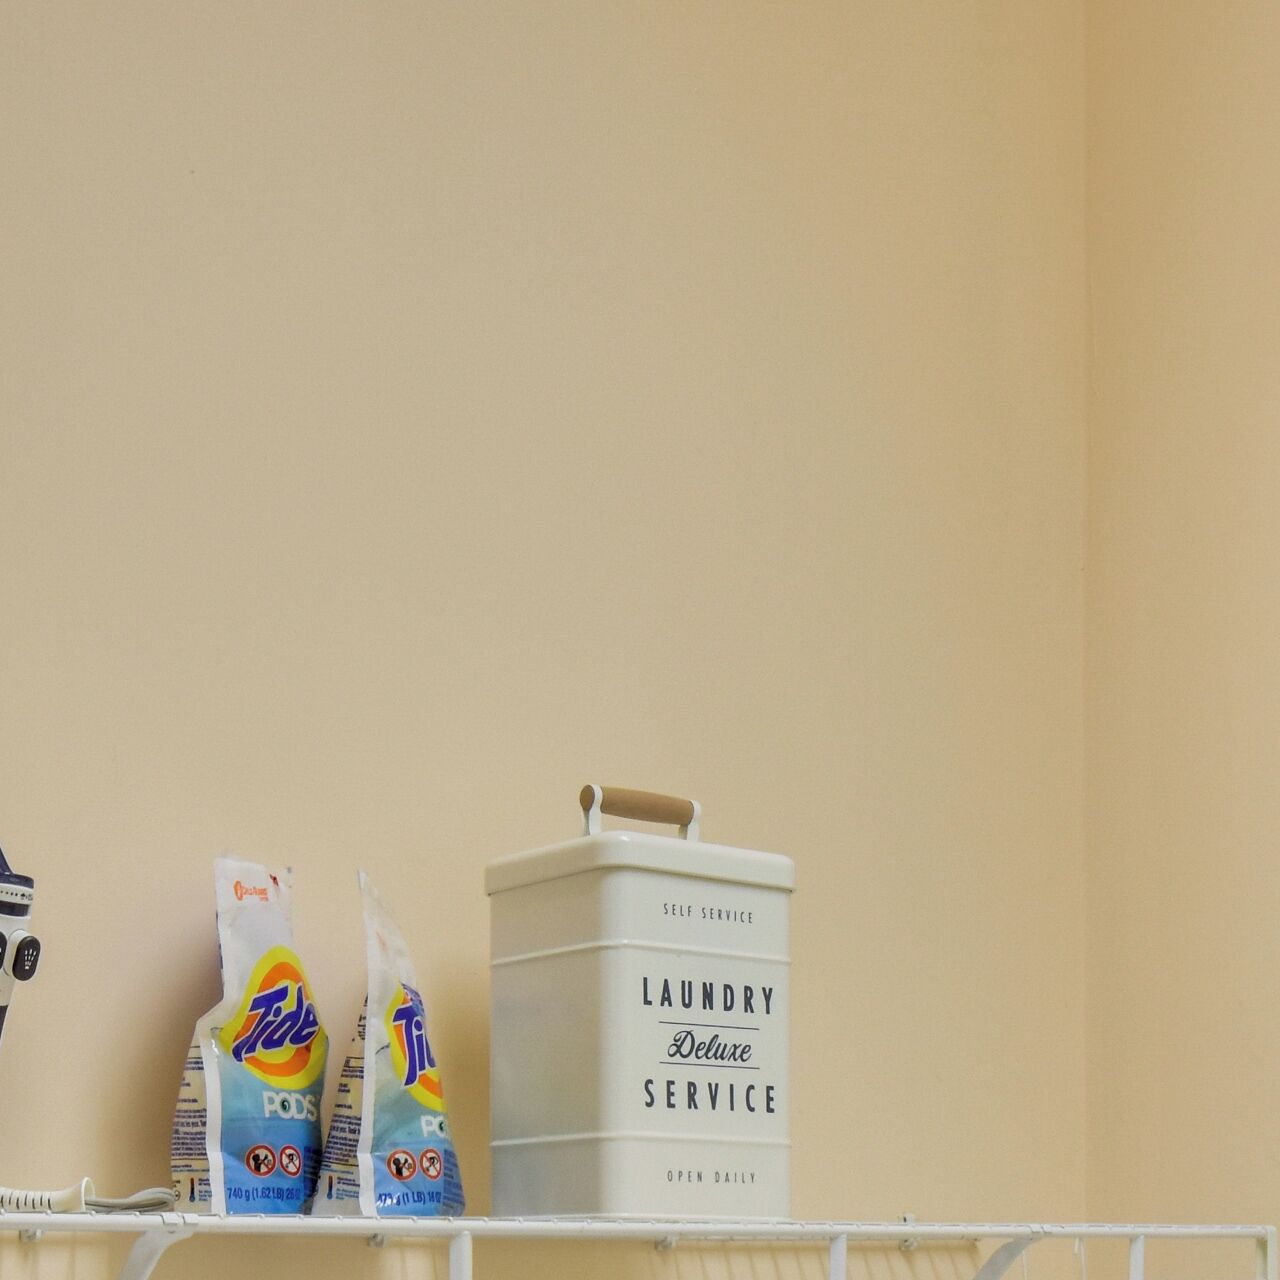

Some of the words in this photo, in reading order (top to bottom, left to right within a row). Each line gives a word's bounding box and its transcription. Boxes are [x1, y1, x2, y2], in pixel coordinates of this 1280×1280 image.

[663, 903, 692, 917] SELF
[701, 907, 753, 924] SERVICE
[643, 977, 773, 1015] LAUNDRY
[231, 983, 320, 1063] Tide
[667, 1030, 753, 1062] Deluxe
[262, 1090, 318, 1121] PODS
[644, 1079, 775, 1113] SERVICE
[667, 1170, 703, 1182] OPEN
[714, 1171, 755, 1184] DAILY
[227, 1188, 243, 1199] 740
[244, 1189, 250, 1202] g
